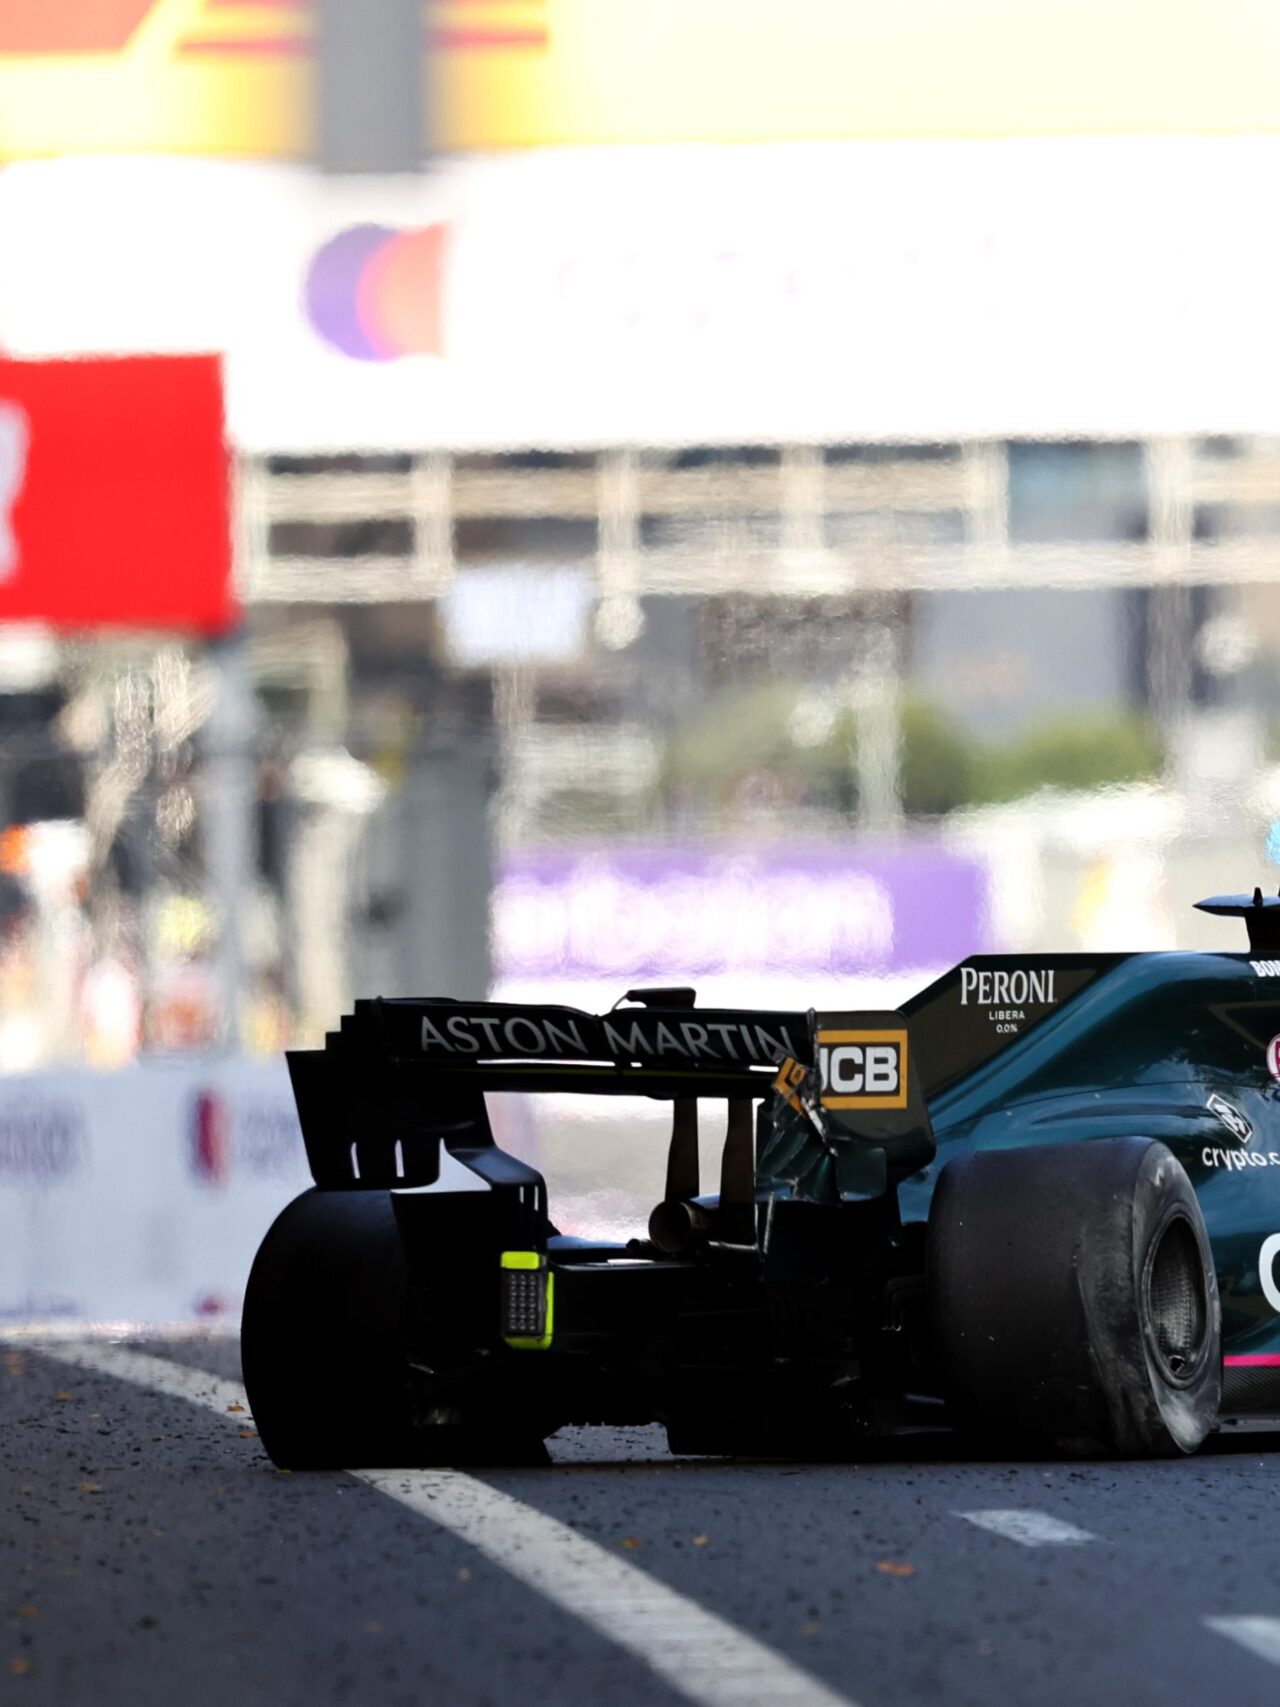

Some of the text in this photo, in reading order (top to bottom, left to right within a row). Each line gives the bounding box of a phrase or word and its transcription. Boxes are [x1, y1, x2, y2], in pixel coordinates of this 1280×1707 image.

[960, 967, 1054, 1005] PERONI
[988, 1010, 1025, 1020] LIBERA
[421, 1015, 799, 1062] ASTON MARTIN
